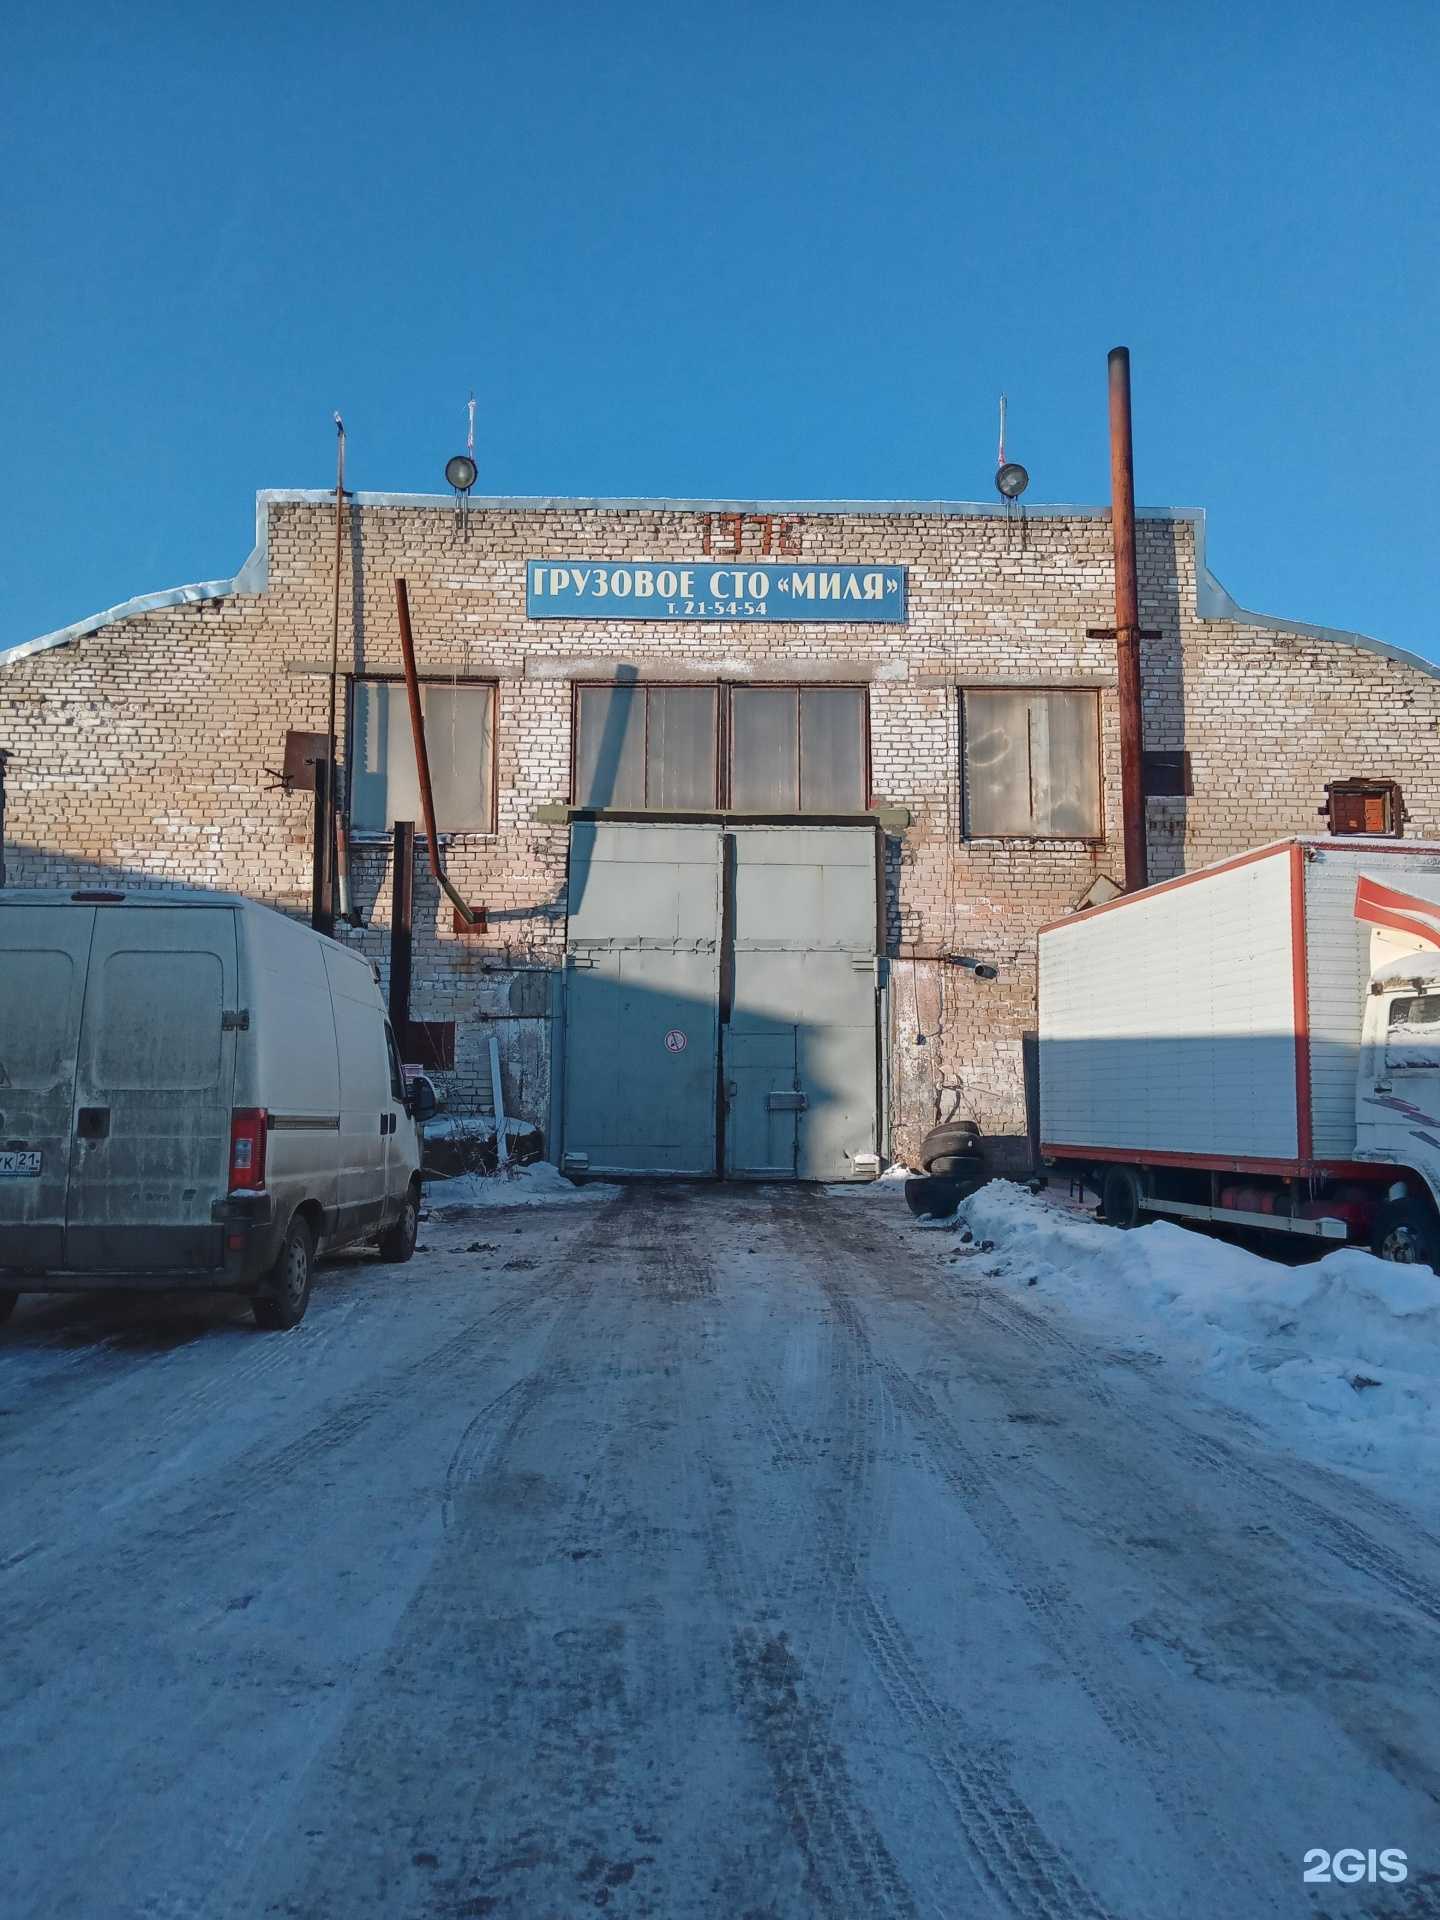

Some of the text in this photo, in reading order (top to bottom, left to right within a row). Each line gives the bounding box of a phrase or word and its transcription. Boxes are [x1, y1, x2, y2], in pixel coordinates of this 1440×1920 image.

[533, 567, 898, 600] ГРУЗОВОЕ СТО «МИЛЯ»
[683, 601, 768, 616] 21-54-54
